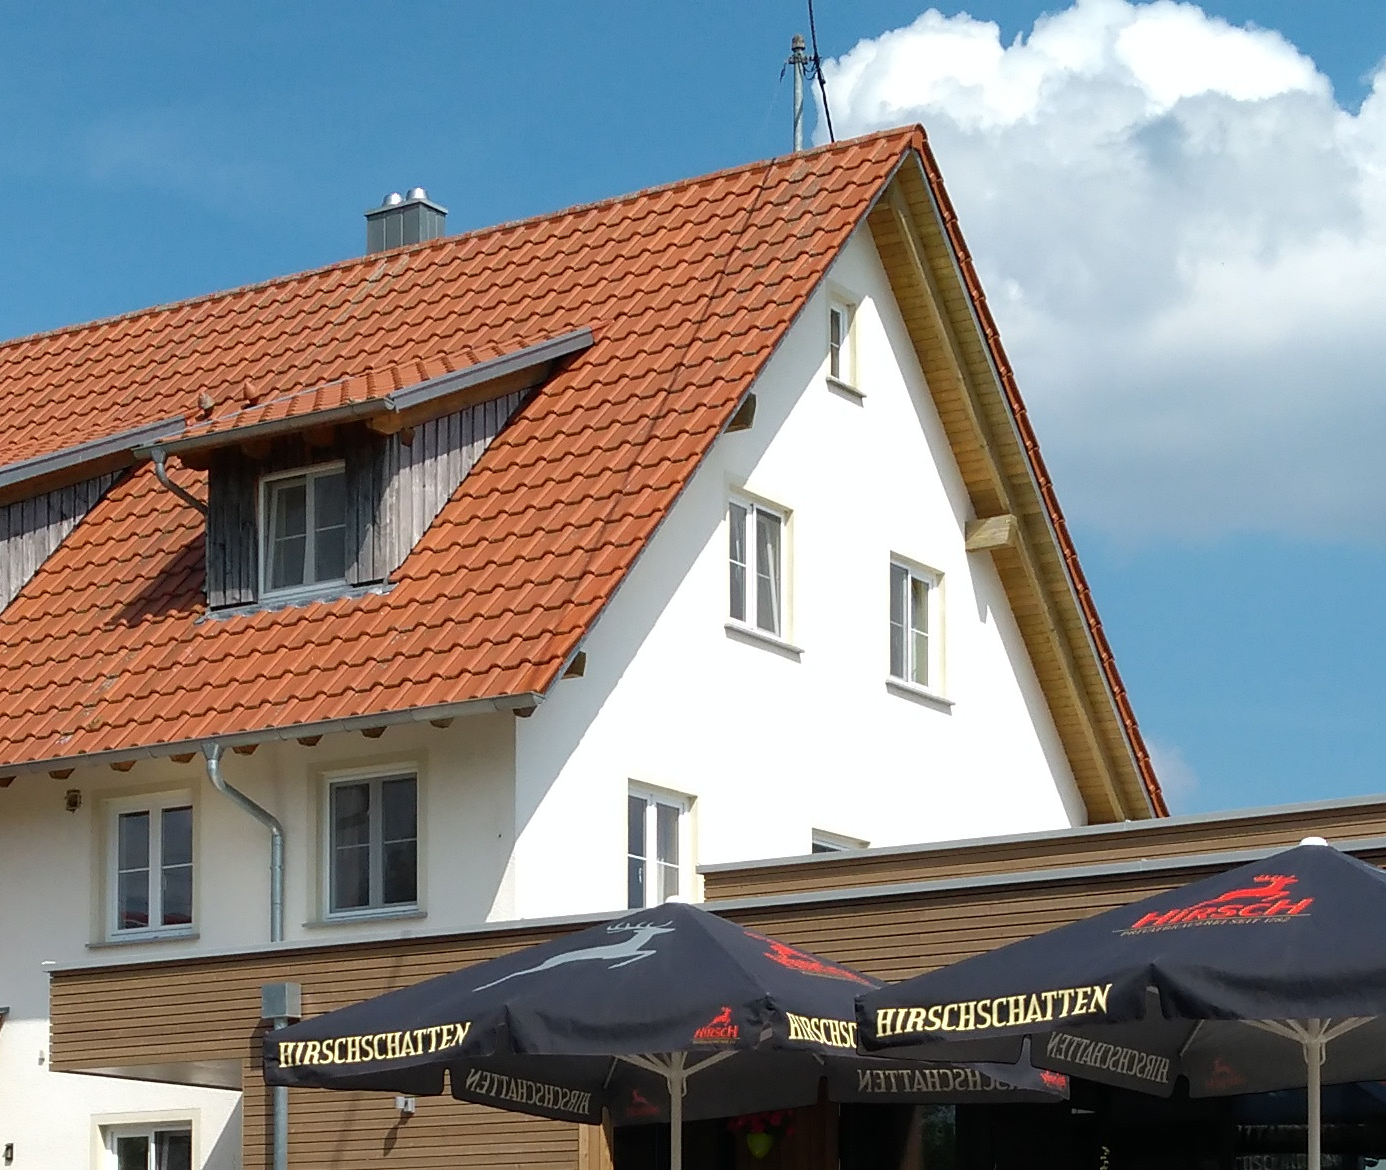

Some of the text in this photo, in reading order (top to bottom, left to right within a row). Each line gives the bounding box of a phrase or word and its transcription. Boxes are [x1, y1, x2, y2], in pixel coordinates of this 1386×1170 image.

[1131, 898, 1314, 928] HIRSCH
[786, 1011, 858, 1049] HIRSCHSC
[876, 983, 1113, 1038] HIRSCHSCHATTEN
[278, 1021, 472, 1069] HIRSCHSCHATTEN
